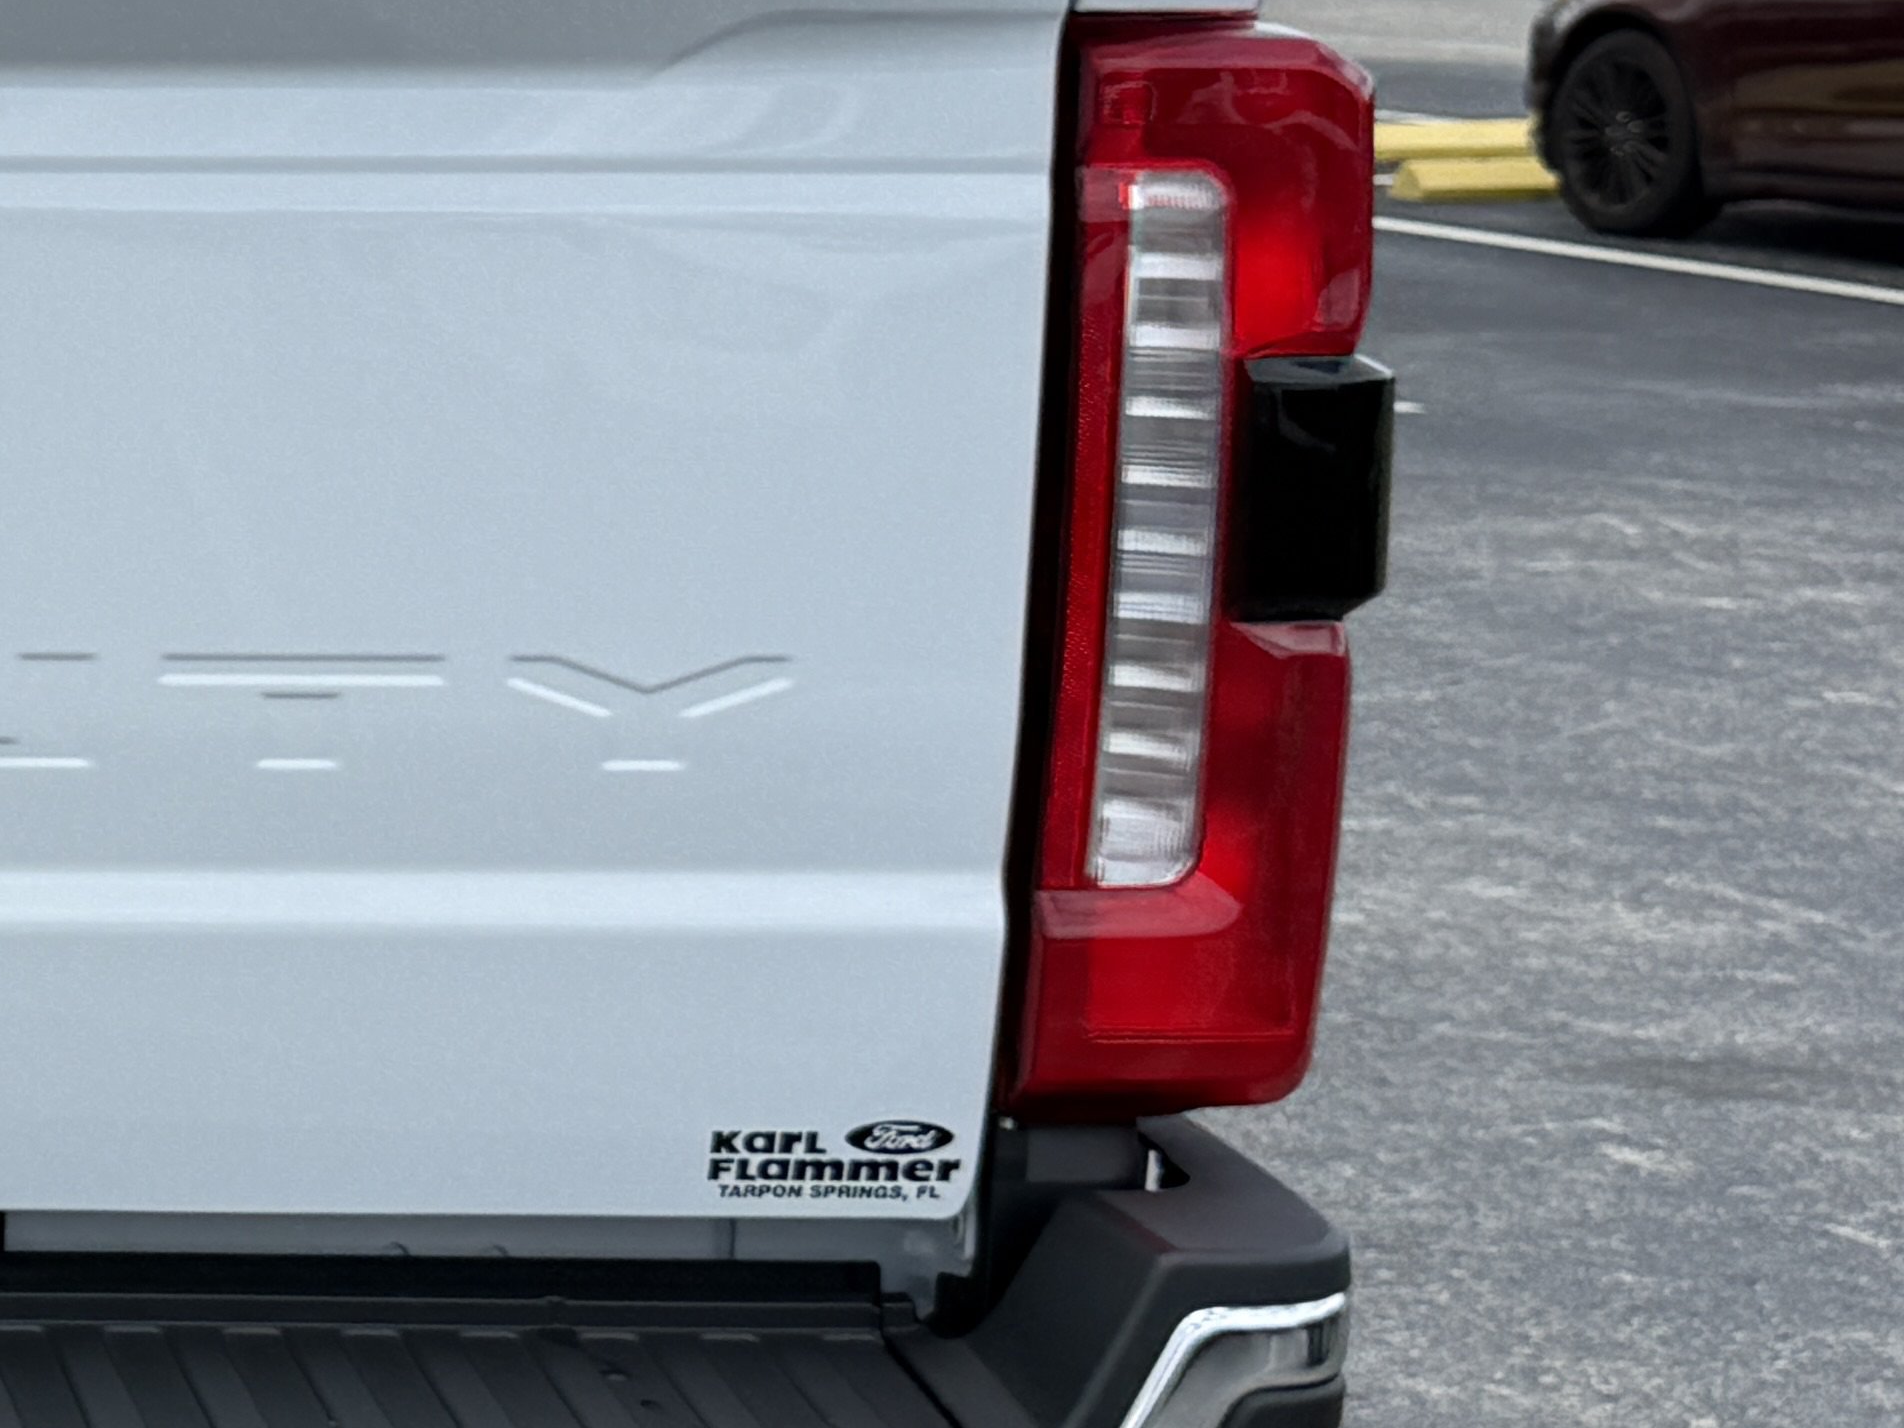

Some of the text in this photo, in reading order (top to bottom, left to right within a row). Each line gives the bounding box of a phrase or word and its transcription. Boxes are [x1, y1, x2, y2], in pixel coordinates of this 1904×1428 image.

[863, 1123, 941, 1151] Ford
[718, 1183, 941, 1203] TARPON SPRINGS, FL
